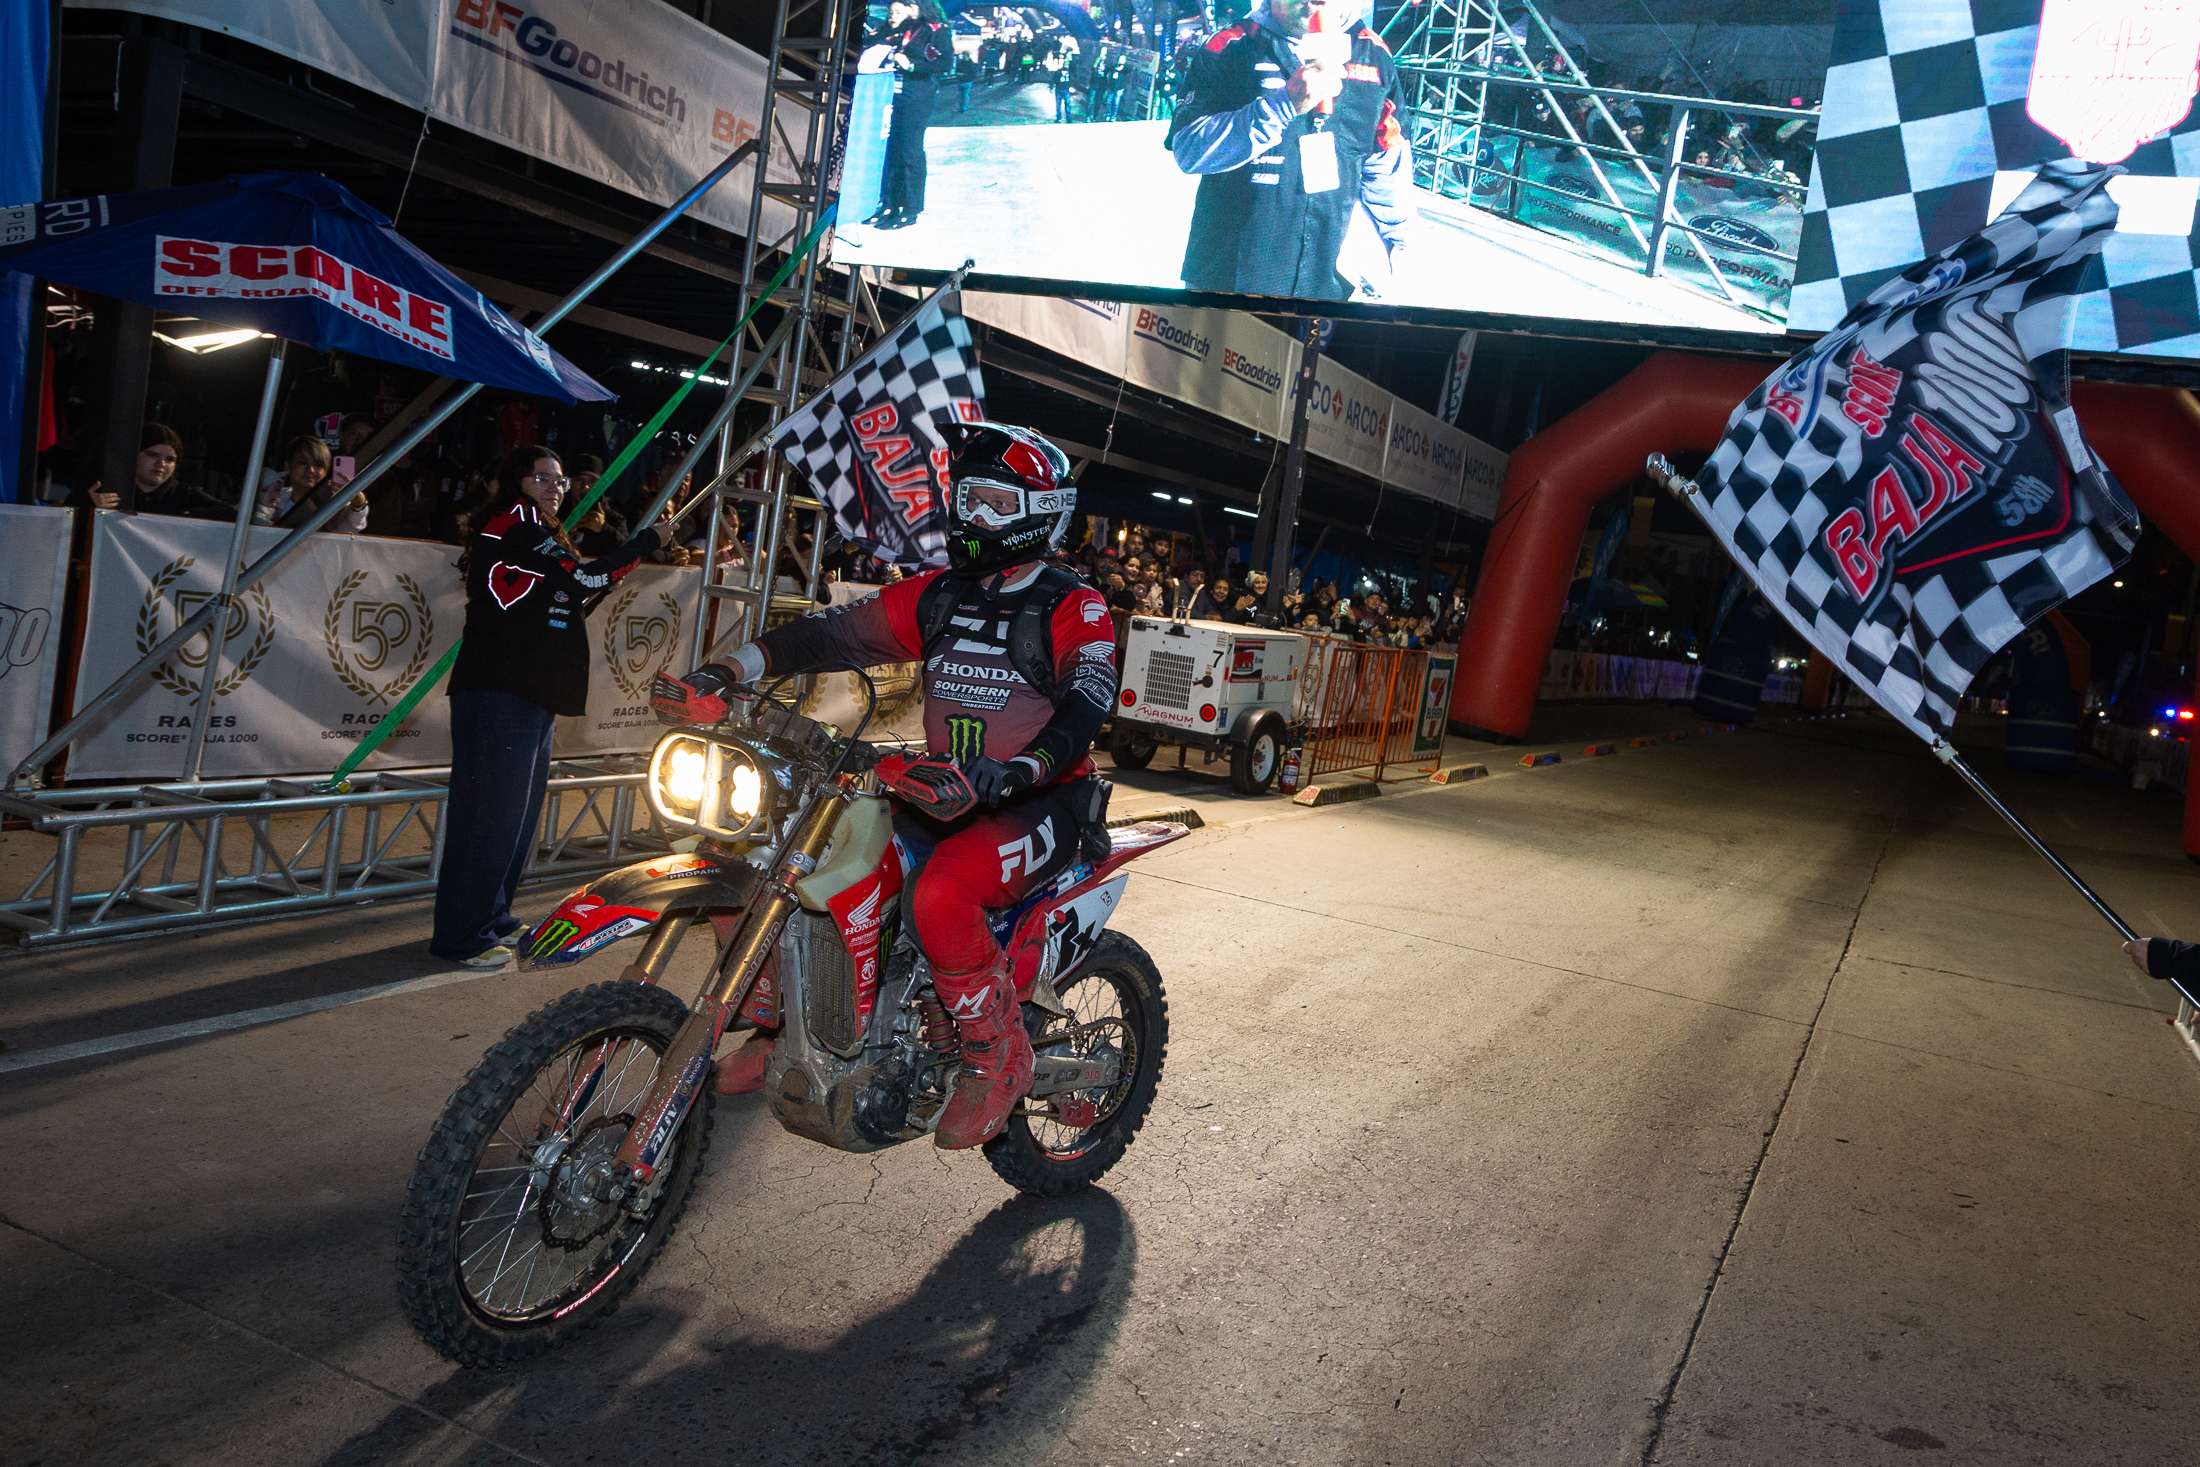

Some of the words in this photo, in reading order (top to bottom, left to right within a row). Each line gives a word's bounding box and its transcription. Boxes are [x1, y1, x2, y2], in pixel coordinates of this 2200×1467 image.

[454, 0, 687, 124] BFGoodrich
[160, 240, 449, 341] SCORE
[160, 285, 330, 301] OFF-ROAD
[340, 303, 452, 359] RACING
[1136, 308, 1210, 358] BFGoodrich
[1224, 347, 1281, 391] BFGoodrich
[1290, 370, 1332, 415] ACO
[1344, 398, 1378, 438] ARCO
[1391, 421, 1421, 456] ARCO
[851, 403, 938, 525] BAJA
[1827, 412, 1986, 603] BAJA
[573, 567, 609, 589] SCORE
[351, 601, 412, 672] 50
[625, 615, 669, 674] 50
[941, 660, 1029, 685] HONDA
[1212, 650, 1224, 668] 7
[932, 688, 1008, 704] POWERSPORTS
[934, 680, 1012, 697] SOUTHERN
[158, 714, 237, 729] RAES
[612, 705, 649, 718] RACES
[229, 731, 259, 744] 1000
[998, 815, 1056, 884] FLY
[669, 867, 721, 880] PROPANE
[844, 917, 880, 936] HONDA
